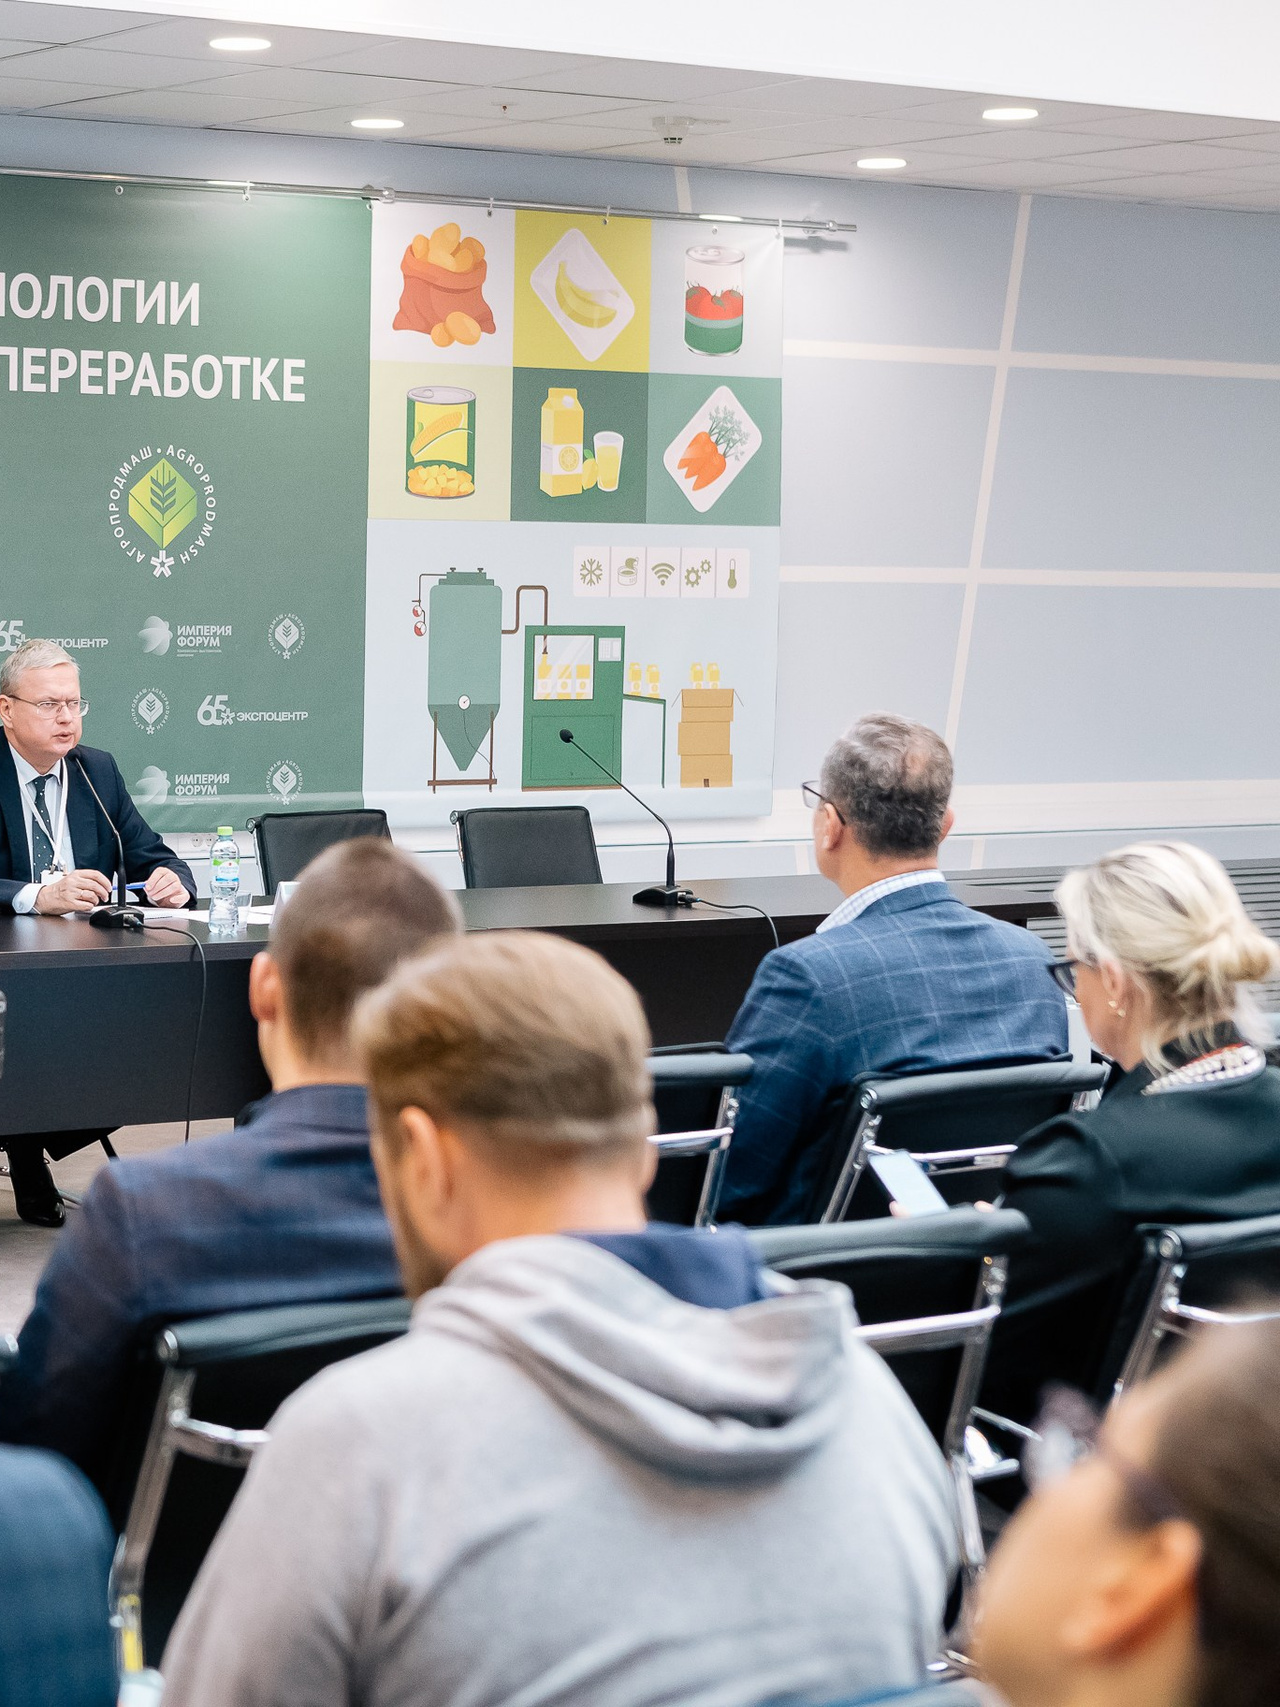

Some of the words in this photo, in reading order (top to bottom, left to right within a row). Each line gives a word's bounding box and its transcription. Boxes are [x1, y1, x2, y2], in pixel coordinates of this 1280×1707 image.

[108, 445, 153, 563] АГРОПРОДМАШ
[165, 444, 217, 564] AGROPRODMASH
[177, 625, 232, 636] ИМПЕРИЯ
[176, 635, 221, 648] ФОРУМ
[196, 694, 229, 727] 65
[236, 711, 309, 723] ЭКСПОЦЕНТР
[175, 773, 230, 785] ИМПЕРИЯ
[174, 785, 218, 797] ФОРУМ
